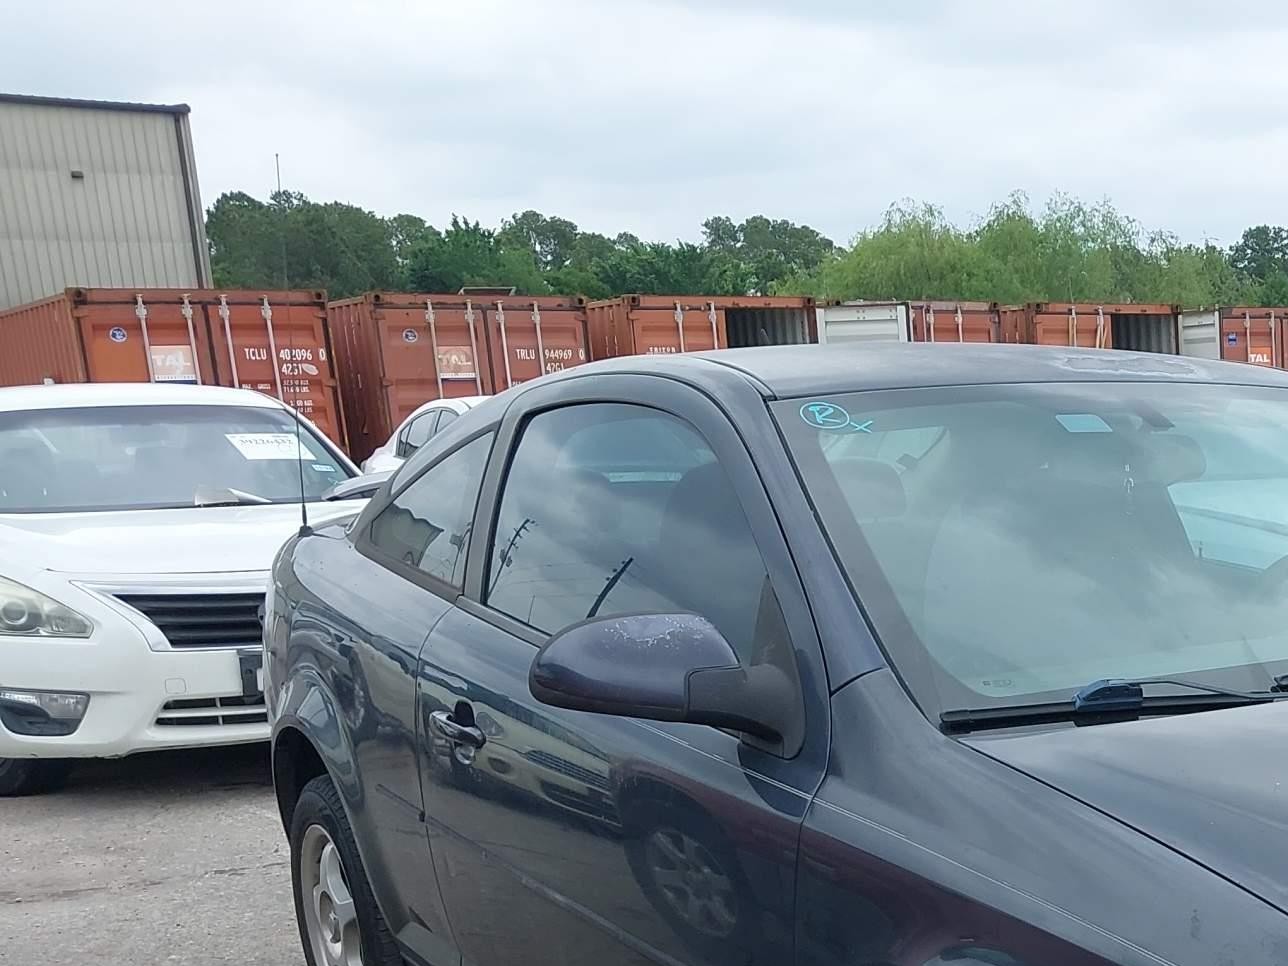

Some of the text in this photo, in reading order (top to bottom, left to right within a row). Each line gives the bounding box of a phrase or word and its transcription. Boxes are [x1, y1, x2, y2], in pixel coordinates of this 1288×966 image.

[244, 348, 267, 360] TCLU
[516, 348, 536, 360] TRLU
[544, 348, 573, 360] 944969
[1249, 353, 1271, 363] TAL
